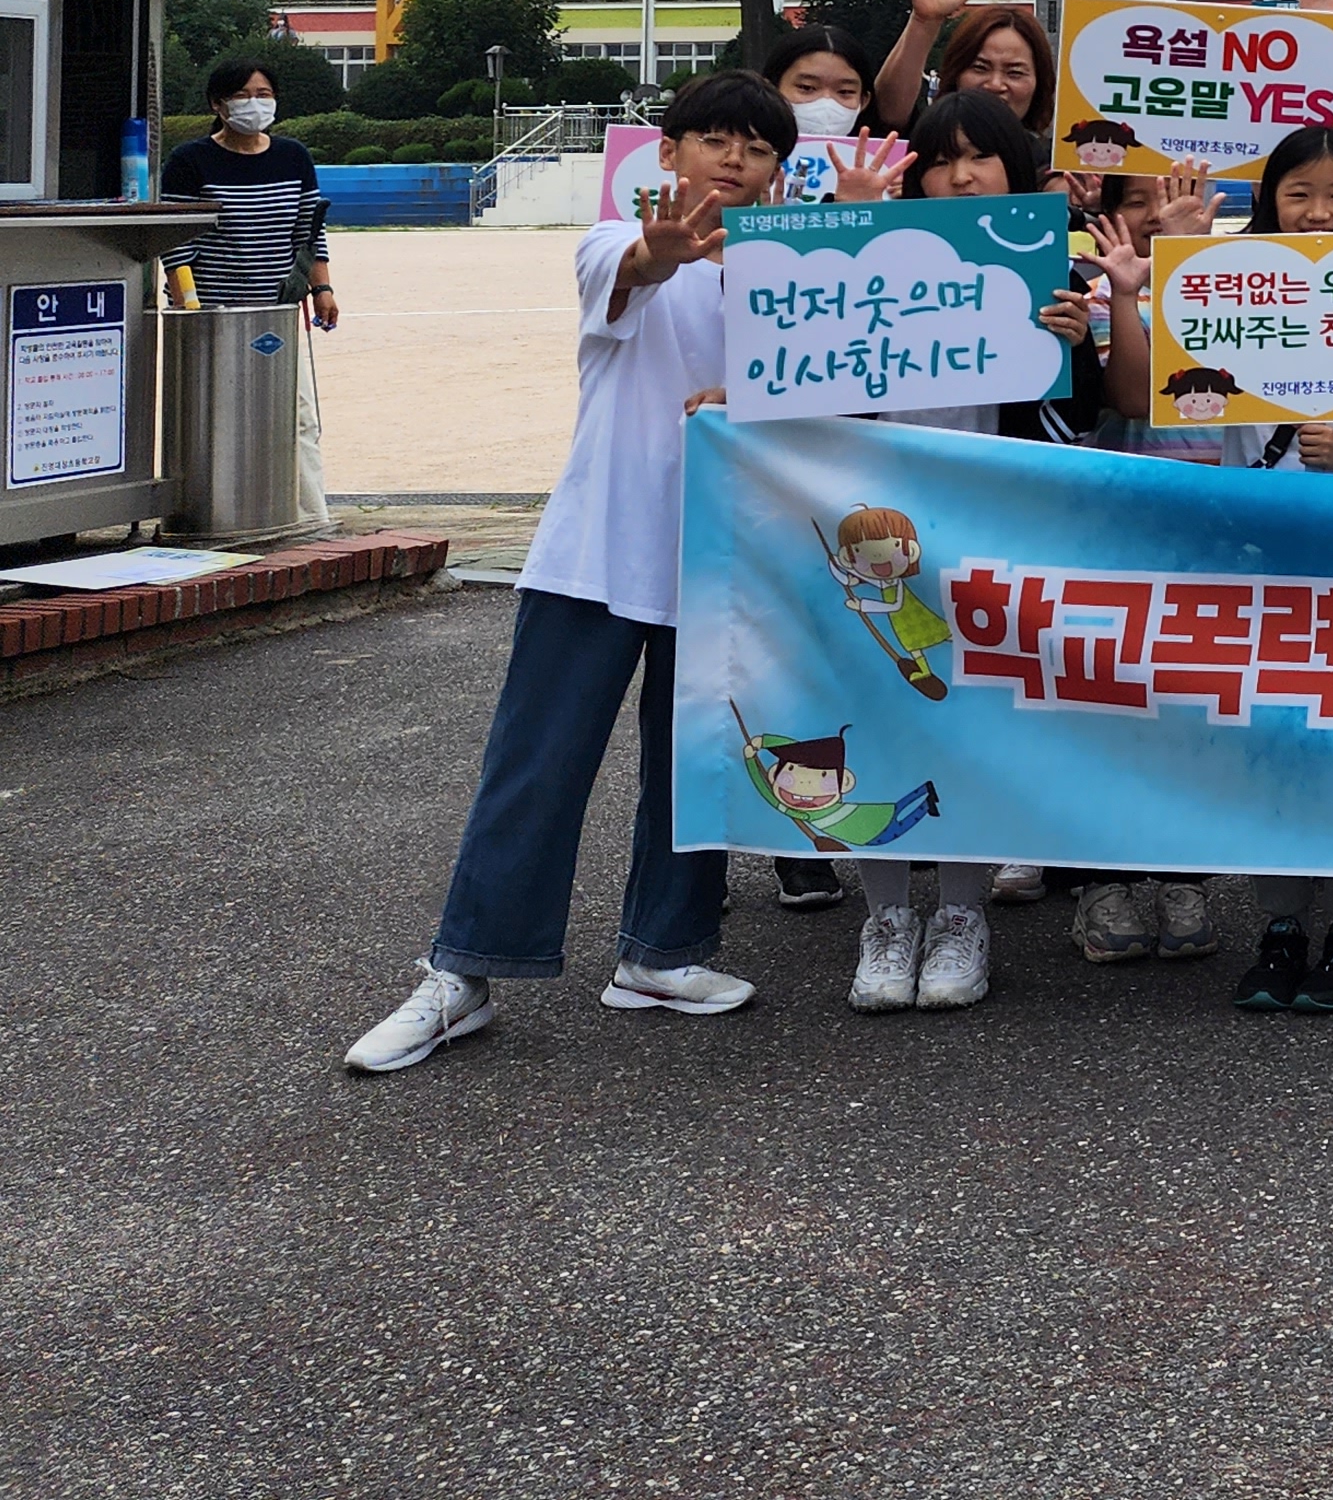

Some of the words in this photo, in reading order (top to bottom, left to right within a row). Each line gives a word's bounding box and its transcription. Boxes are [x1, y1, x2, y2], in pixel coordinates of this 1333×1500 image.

[1121, 24, 1209, 68] 욕설
[1222, 29, 1298, 73] NO
[1099, 74, 1235, 120] 고운말
[1160, 137, 1261, 156] 진영대창초등학교
[738, 210, 874, 232] 진영대창초등학교
[749, 281, 846, 330] 먼저
[854, 273, 984, 334] 웃으며
[1179, 271, 1311, 307] 폭력없는
[1180, 315, 1311, 351] 감싸주는
[747, 336, 997, 398] 인사합시다
